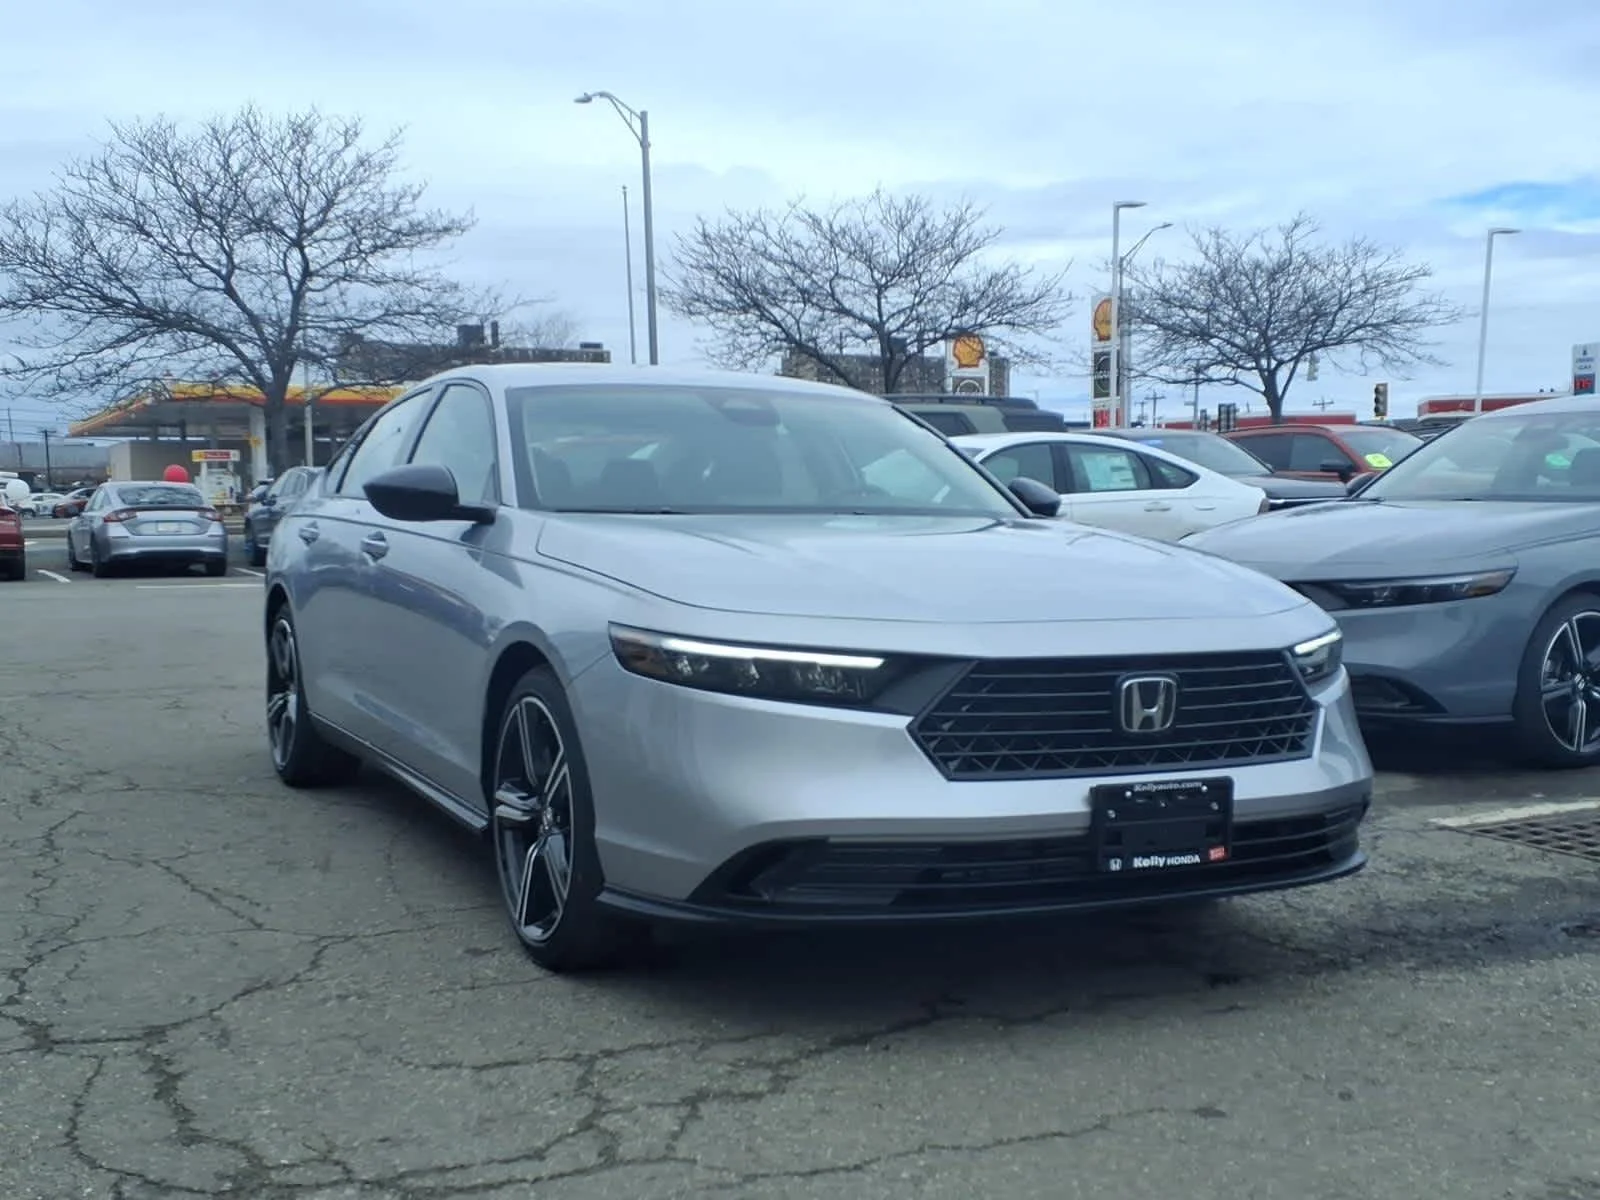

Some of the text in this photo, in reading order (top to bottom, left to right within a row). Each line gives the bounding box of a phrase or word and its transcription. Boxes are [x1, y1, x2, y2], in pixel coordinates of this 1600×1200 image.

[1133, 781, 1202, 793] Kellyauto.com
[1133, 854, 1201, 869] Kelly HONDA
